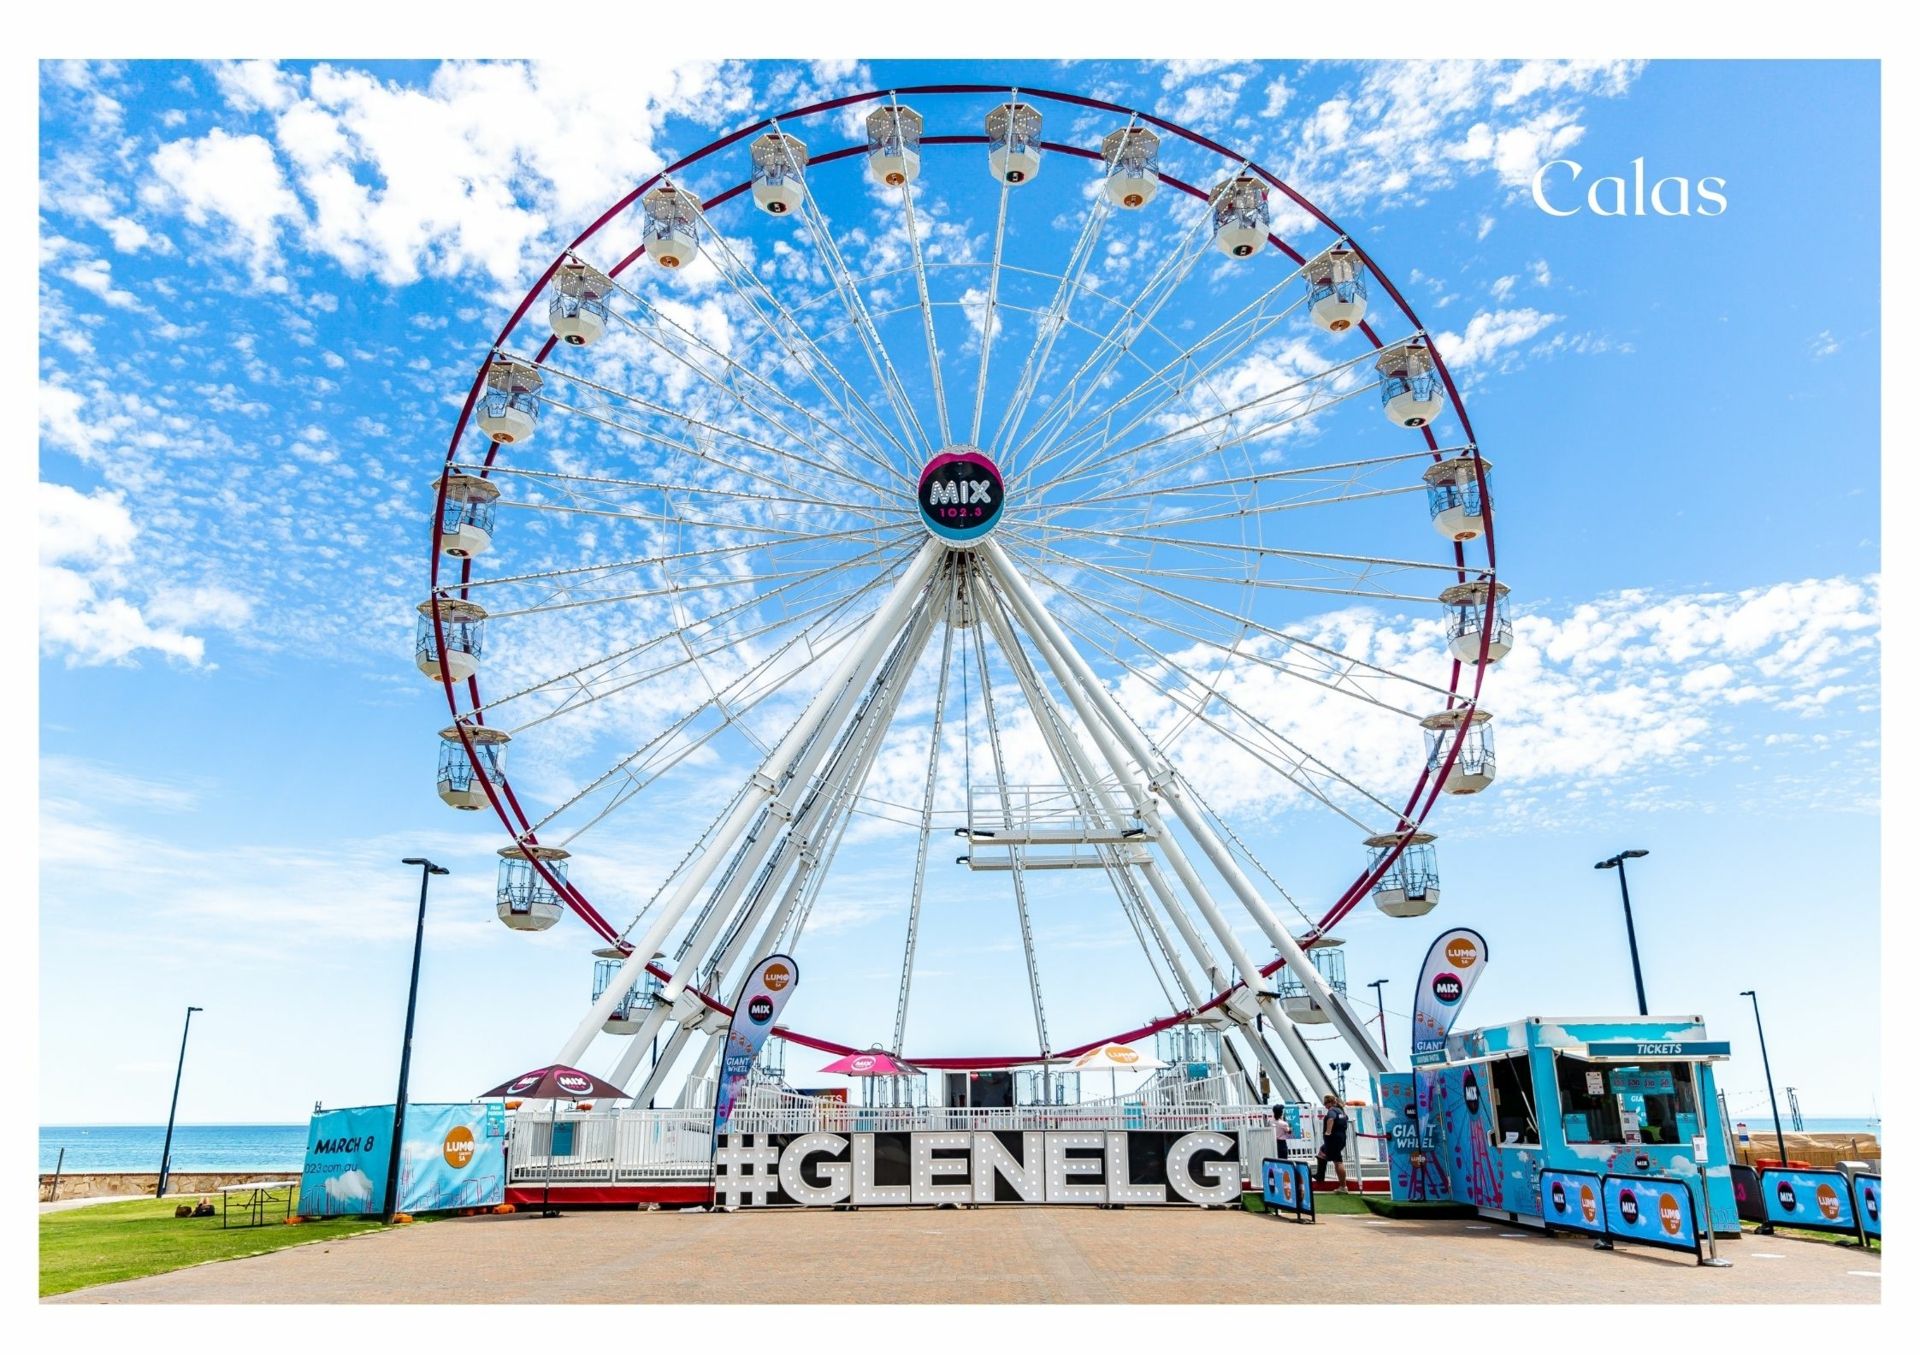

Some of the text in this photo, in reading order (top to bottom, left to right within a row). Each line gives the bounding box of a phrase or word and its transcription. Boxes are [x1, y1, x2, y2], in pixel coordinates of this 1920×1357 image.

[929, 480, 991, 505] MIX
[940, 507, 982, 517] 102.3
[1448, 949, 1476, 957] LUMO
[1436, 983, 1459, 993] MIX
[751, 1005, 770, 1013] MIX
[1417, 1041, 1443, 1051] GIANT
[1637, 1044, 1682, 1054] TICKETS
[726, 1057, 750, 1066] GIANT
[728, 1065, 747, 1073] WHEEL
[560, 1077, 586, 1086] MIX
[1465, 1086, 1477, 1101] MIX
[1392, 1124, 1437, 1138] GIAT
[314, 1137, 362, 1155] MARCH
[364, 1136, 375, 1152] 8
[446, 1141, 475, 1152] LUMO
[715, 1132, 1241, 1205] #GLENELG
[1553, 1193, 1565, 1204] MIX
[1780, 1192, 1794, 1203] MIX
[1622, 1201, 1637, 1214] MIX
